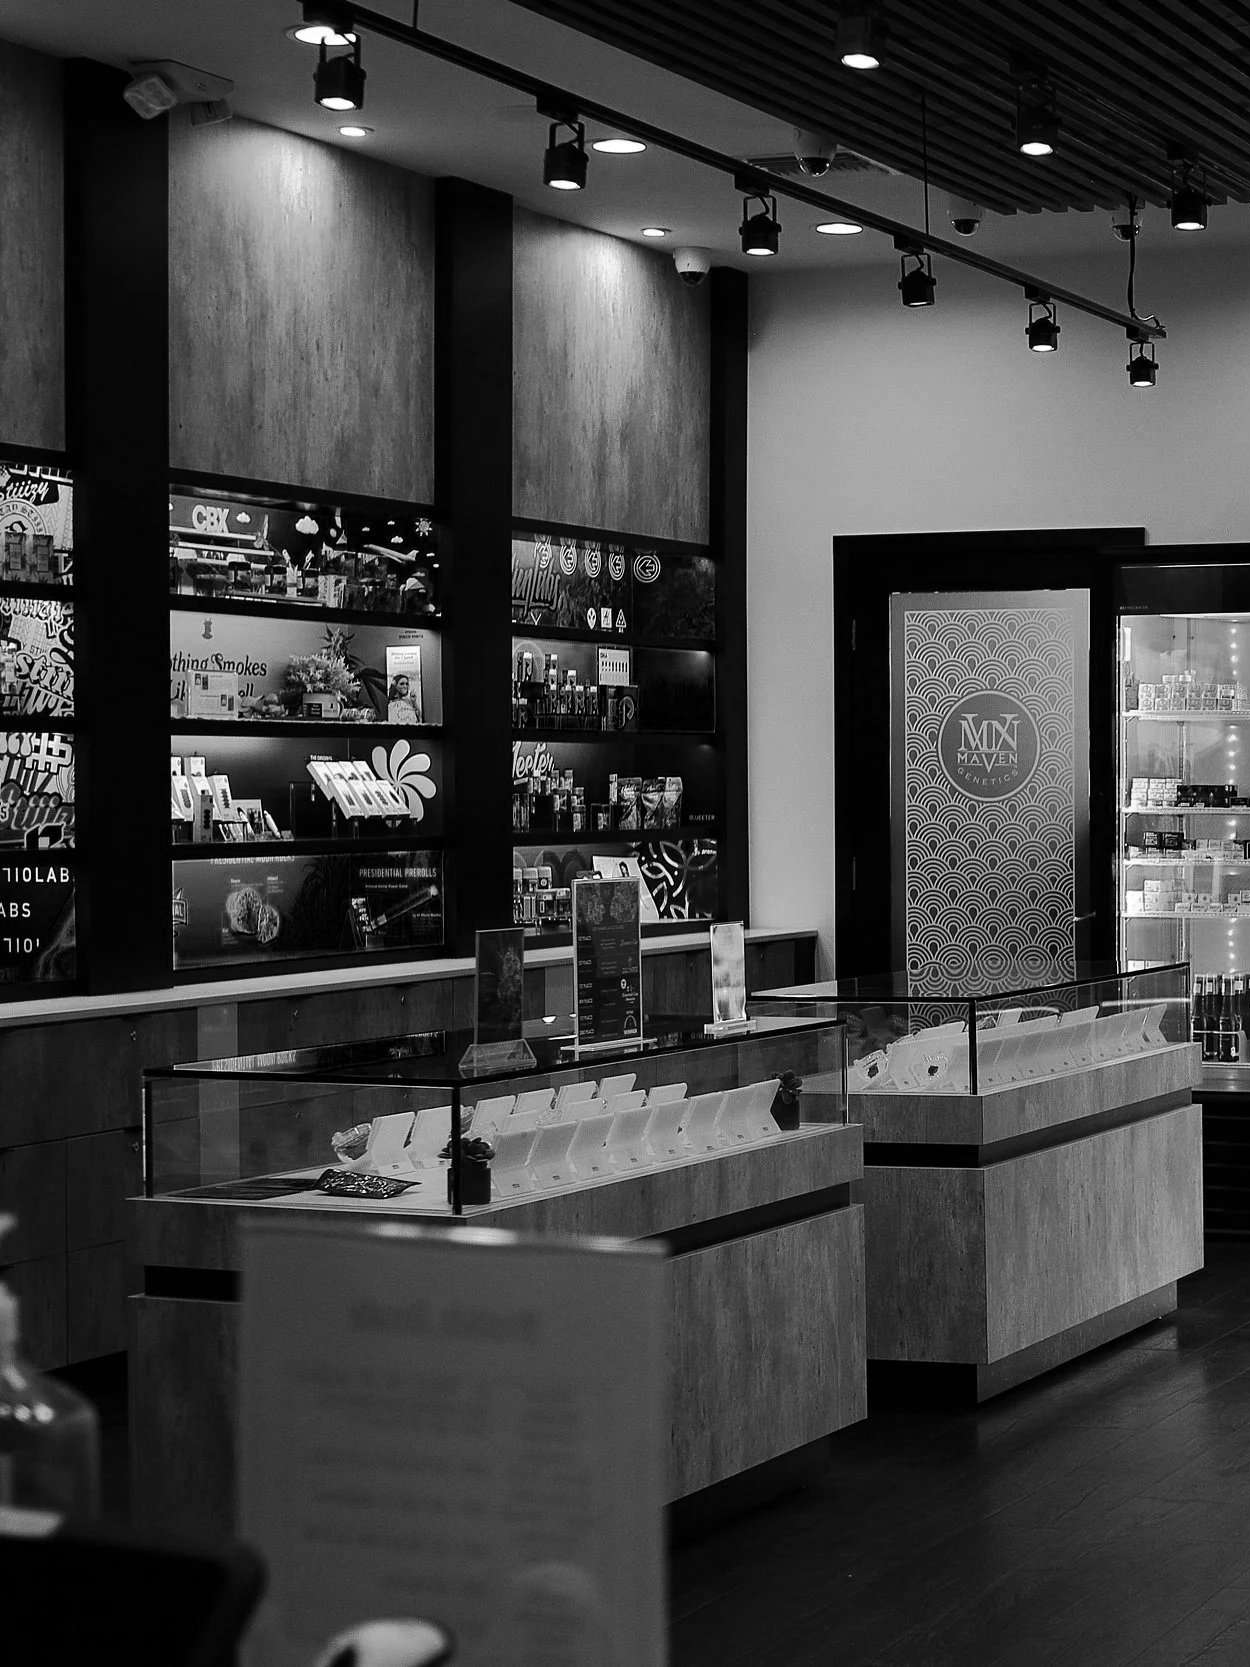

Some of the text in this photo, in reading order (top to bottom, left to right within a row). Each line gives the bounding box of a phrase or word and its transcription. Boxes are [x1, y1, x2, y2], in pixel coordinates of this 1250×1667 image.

[192, 504, 230, 533] CBX
[211, 653, 268, 676] Smokes
[957, 752, 1019, 774] MAVEN
[957, 767, 1019, 786] GENETICS
[359, 867, 437, 878] PRESIDENTIAL PREROLLS
